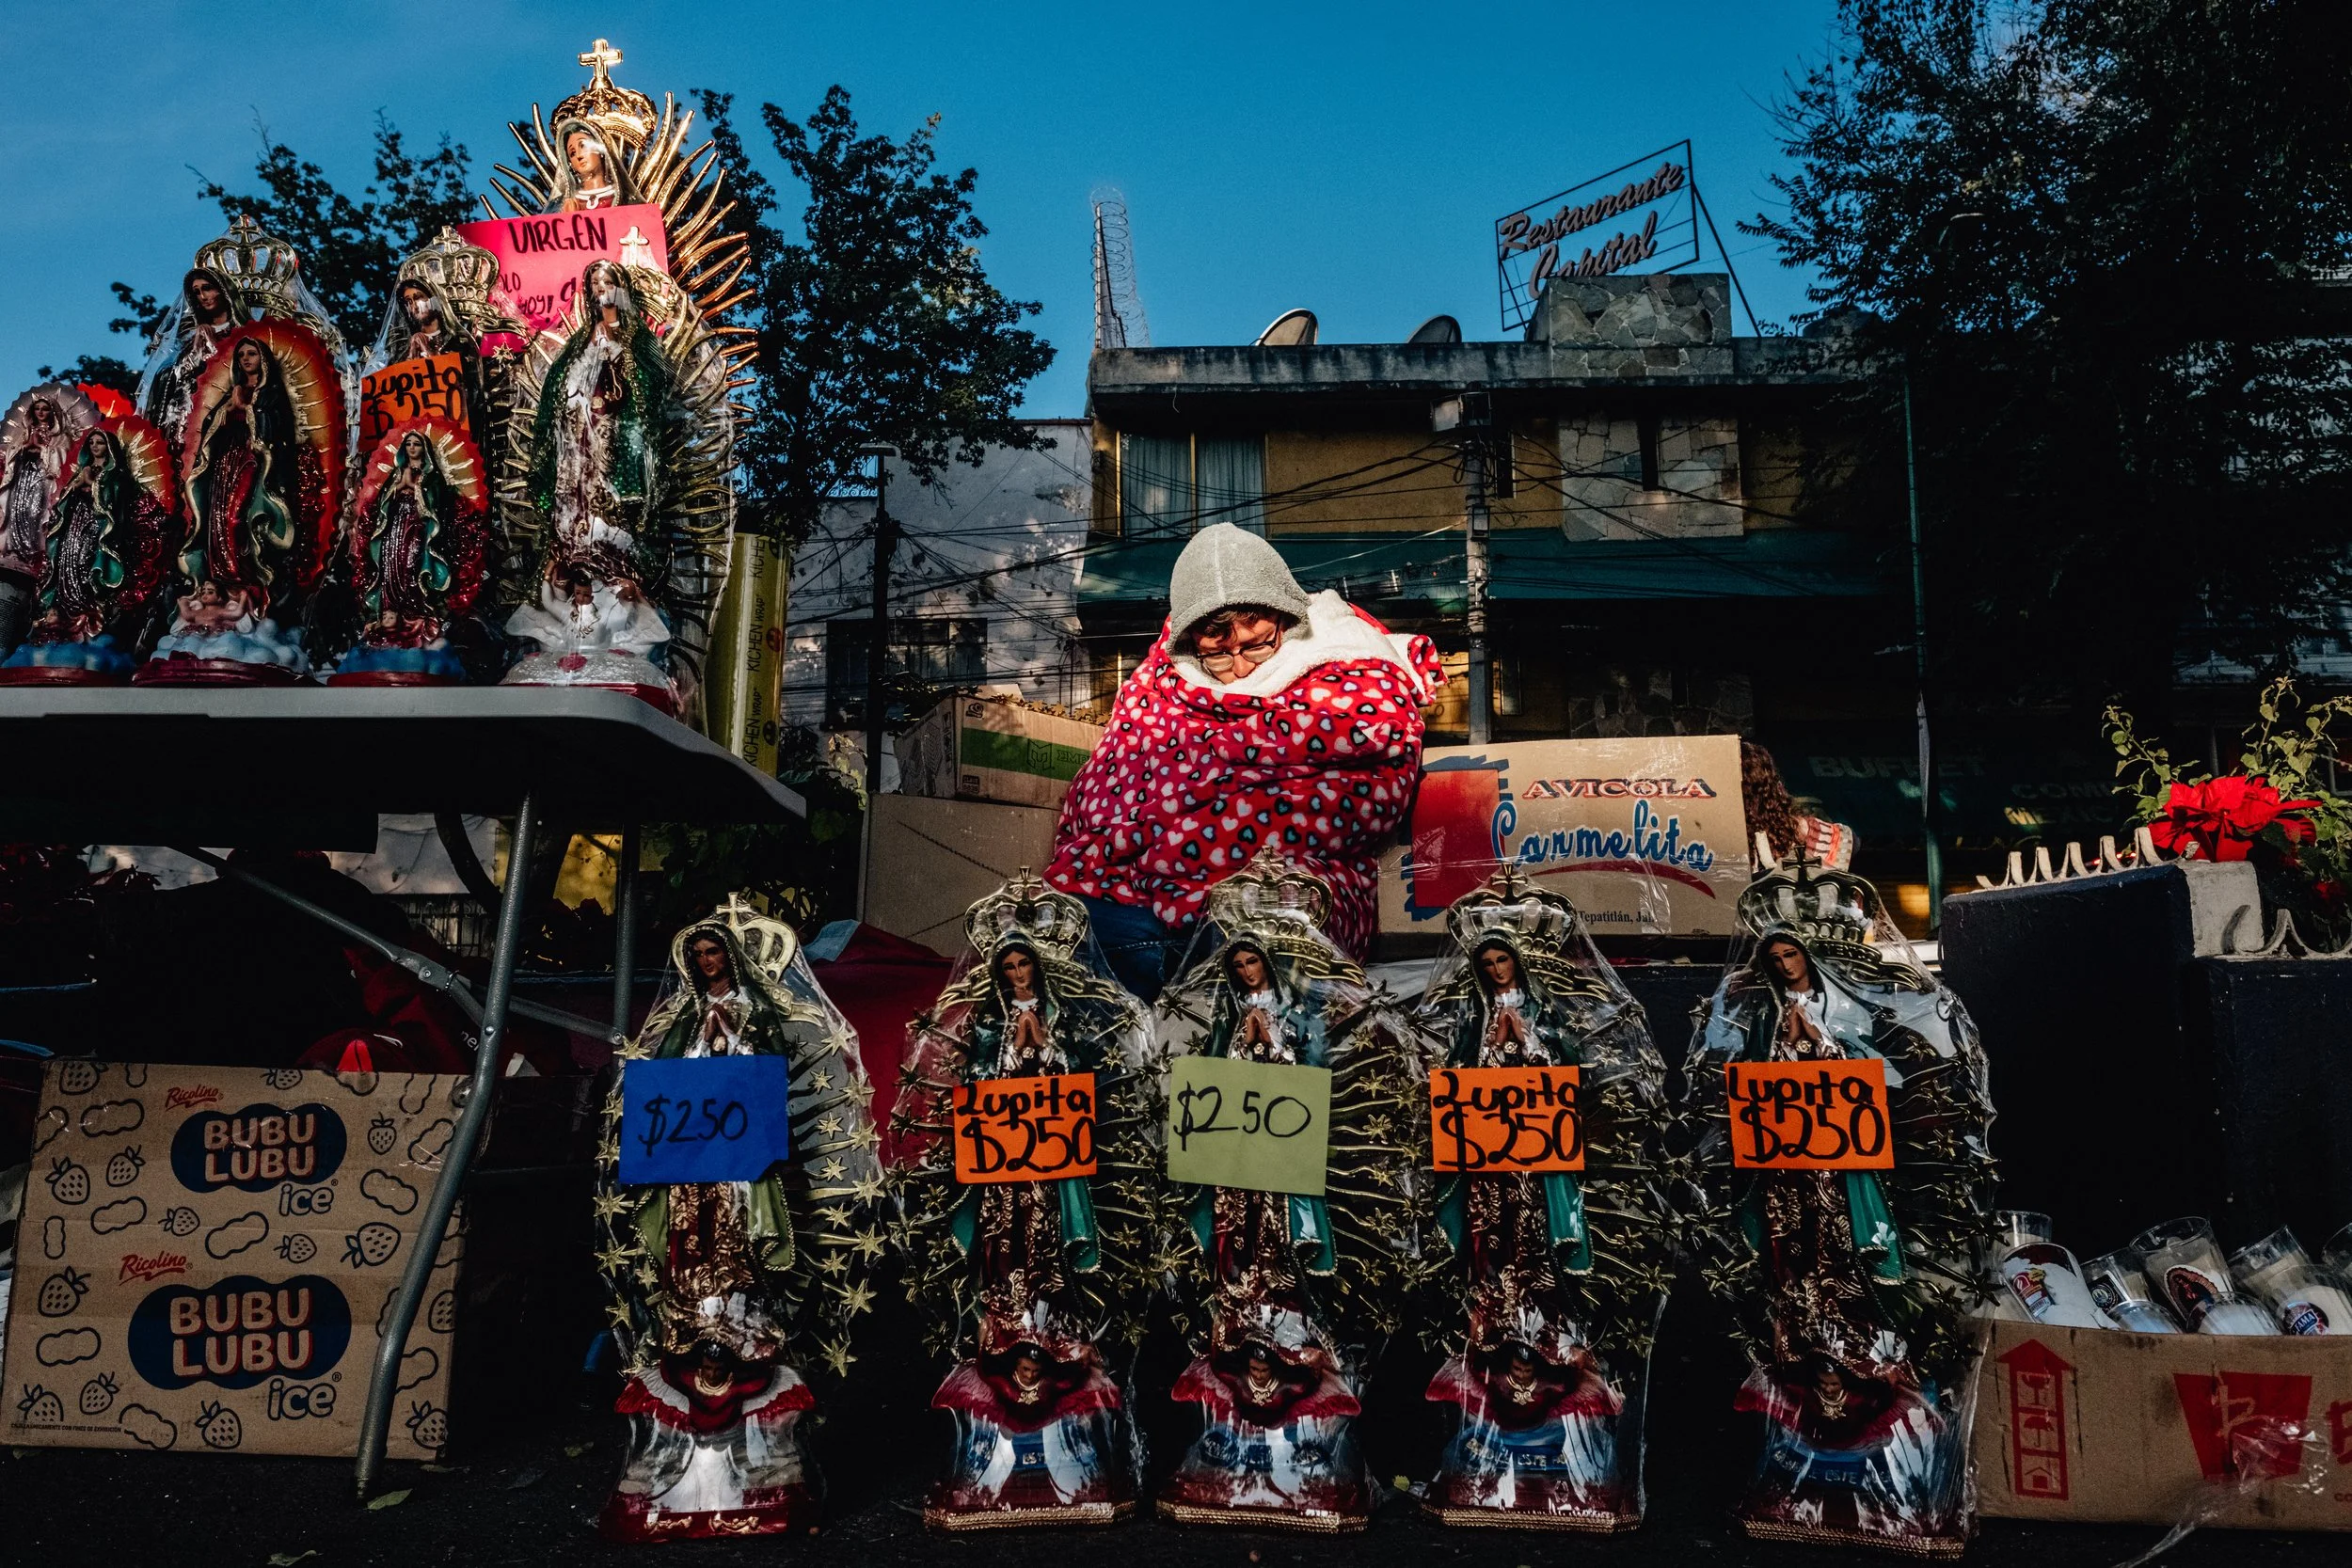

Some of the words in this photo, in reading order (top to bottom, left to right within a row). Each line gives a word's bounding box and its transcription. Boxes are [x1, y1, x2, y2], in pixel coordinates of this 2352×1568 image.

[508, 214, 607, 254] VIRGEN
[1500, 161, 1685, 261] Restaurante
[362, 358, 462, 407] Lupita
[746, 623, 763, 673] KICHEN
[1521, 778, 1717, 800] AVICOLA
[1490, 800, 1713, 872] Carmelita
[166, 1085, 219, 1109] Ricolino
[956, 1078, 1091, 1131] Lupita
[1173, 1081, 1311, 1151] $250
[1433, 1070, 1582, 1124] Lupita
[1728, 1067, 1875, 1124] Lupita
[204, 1114, 315, 1150] BUBU
[638, 1094, 748, 1157] $250
[961, 1117, 1097, 1173] $250
[1438, 1104, 1582, 1172] $250
[1740, 1101, 1885, 1164] $250
[205, 1146, 313, 1183] LUBU
[279, 1183, 335, 1216] ice
[119, 1251, 186, 1283] Ricolino
[170, 1288, 311, 1336] BUBU
[172, 1329, 312, 1377] LUBU
[267, 1378, 337, 1420] ice
